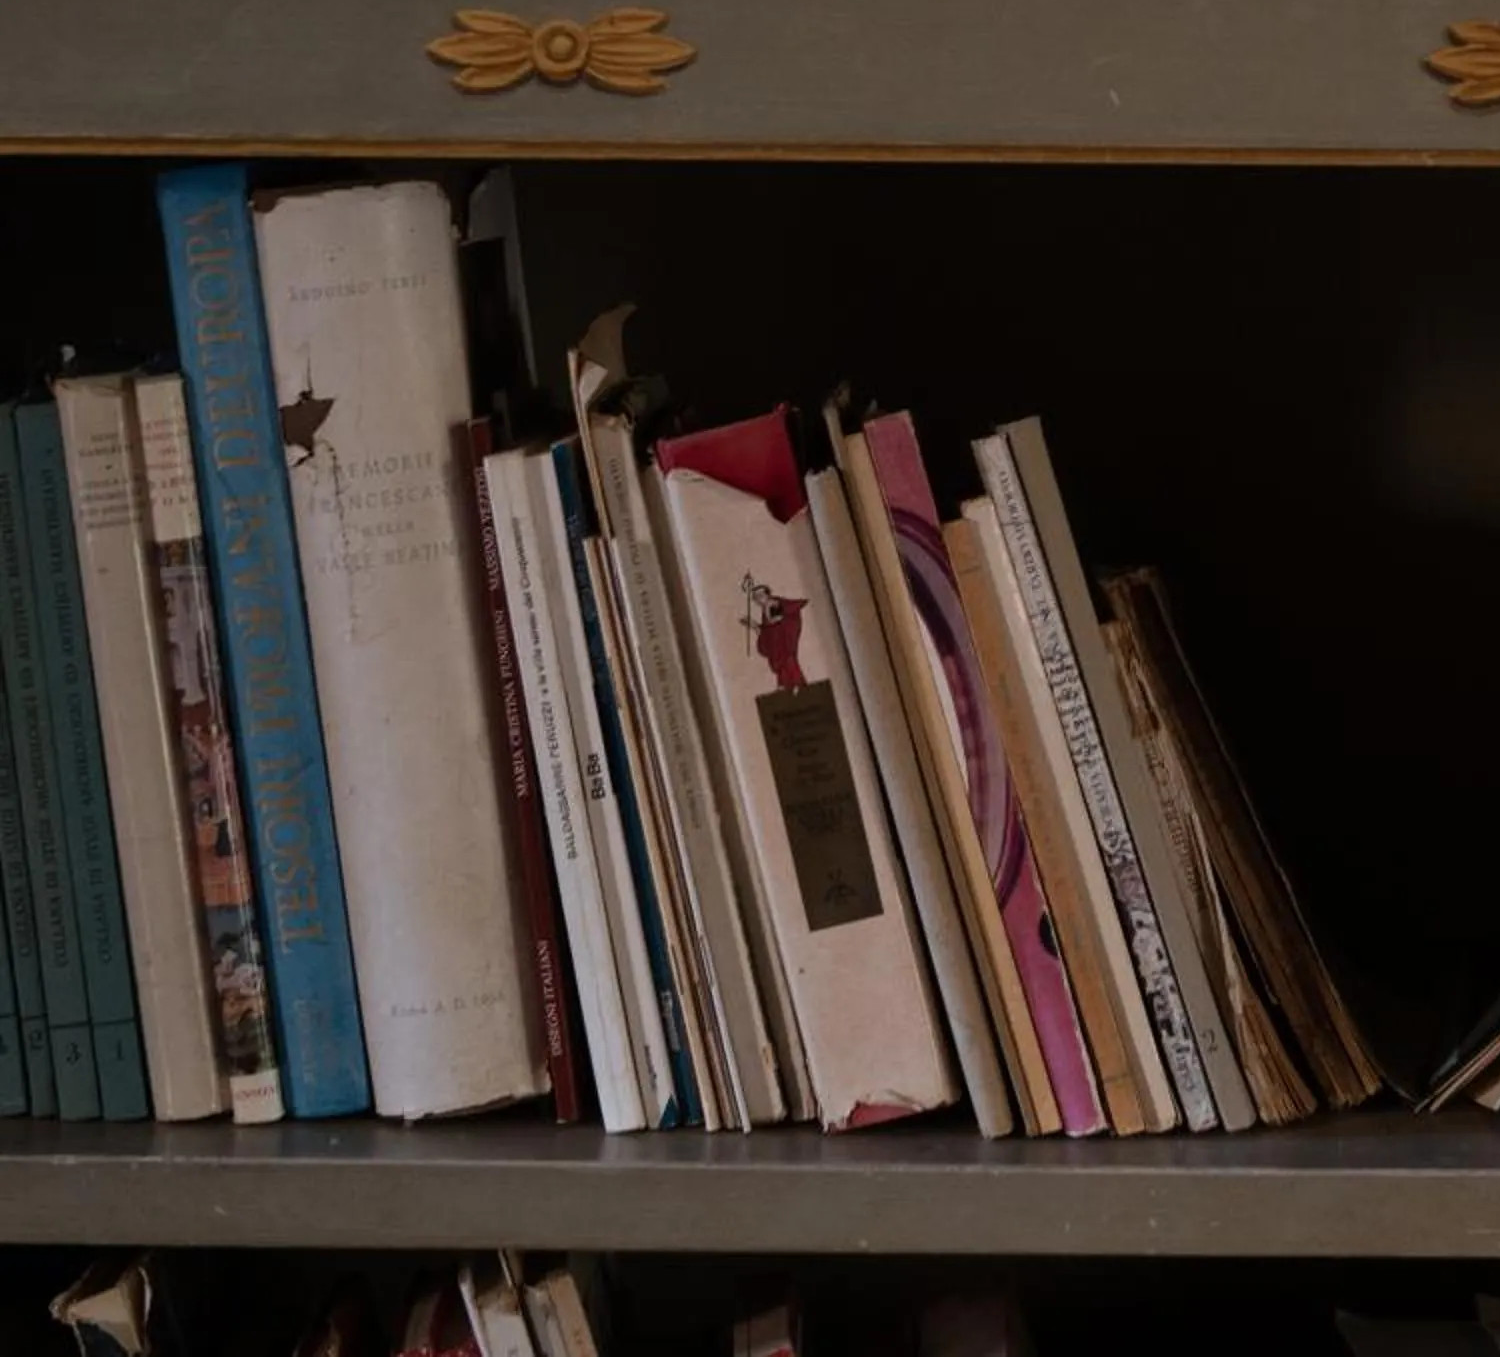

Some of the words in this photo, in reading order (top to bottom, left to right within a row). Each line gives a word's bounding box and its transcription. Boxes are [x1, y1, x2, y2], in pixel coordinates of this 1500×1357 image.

[309, 483, 450, 516] FRANCESCAN
[383, 540, 454, 565] REATIN
[510, 747, 531, 798] MARIA
[250, 759, 329, 958] TESORI
[534, 938, 556, 999] ITALIANI
